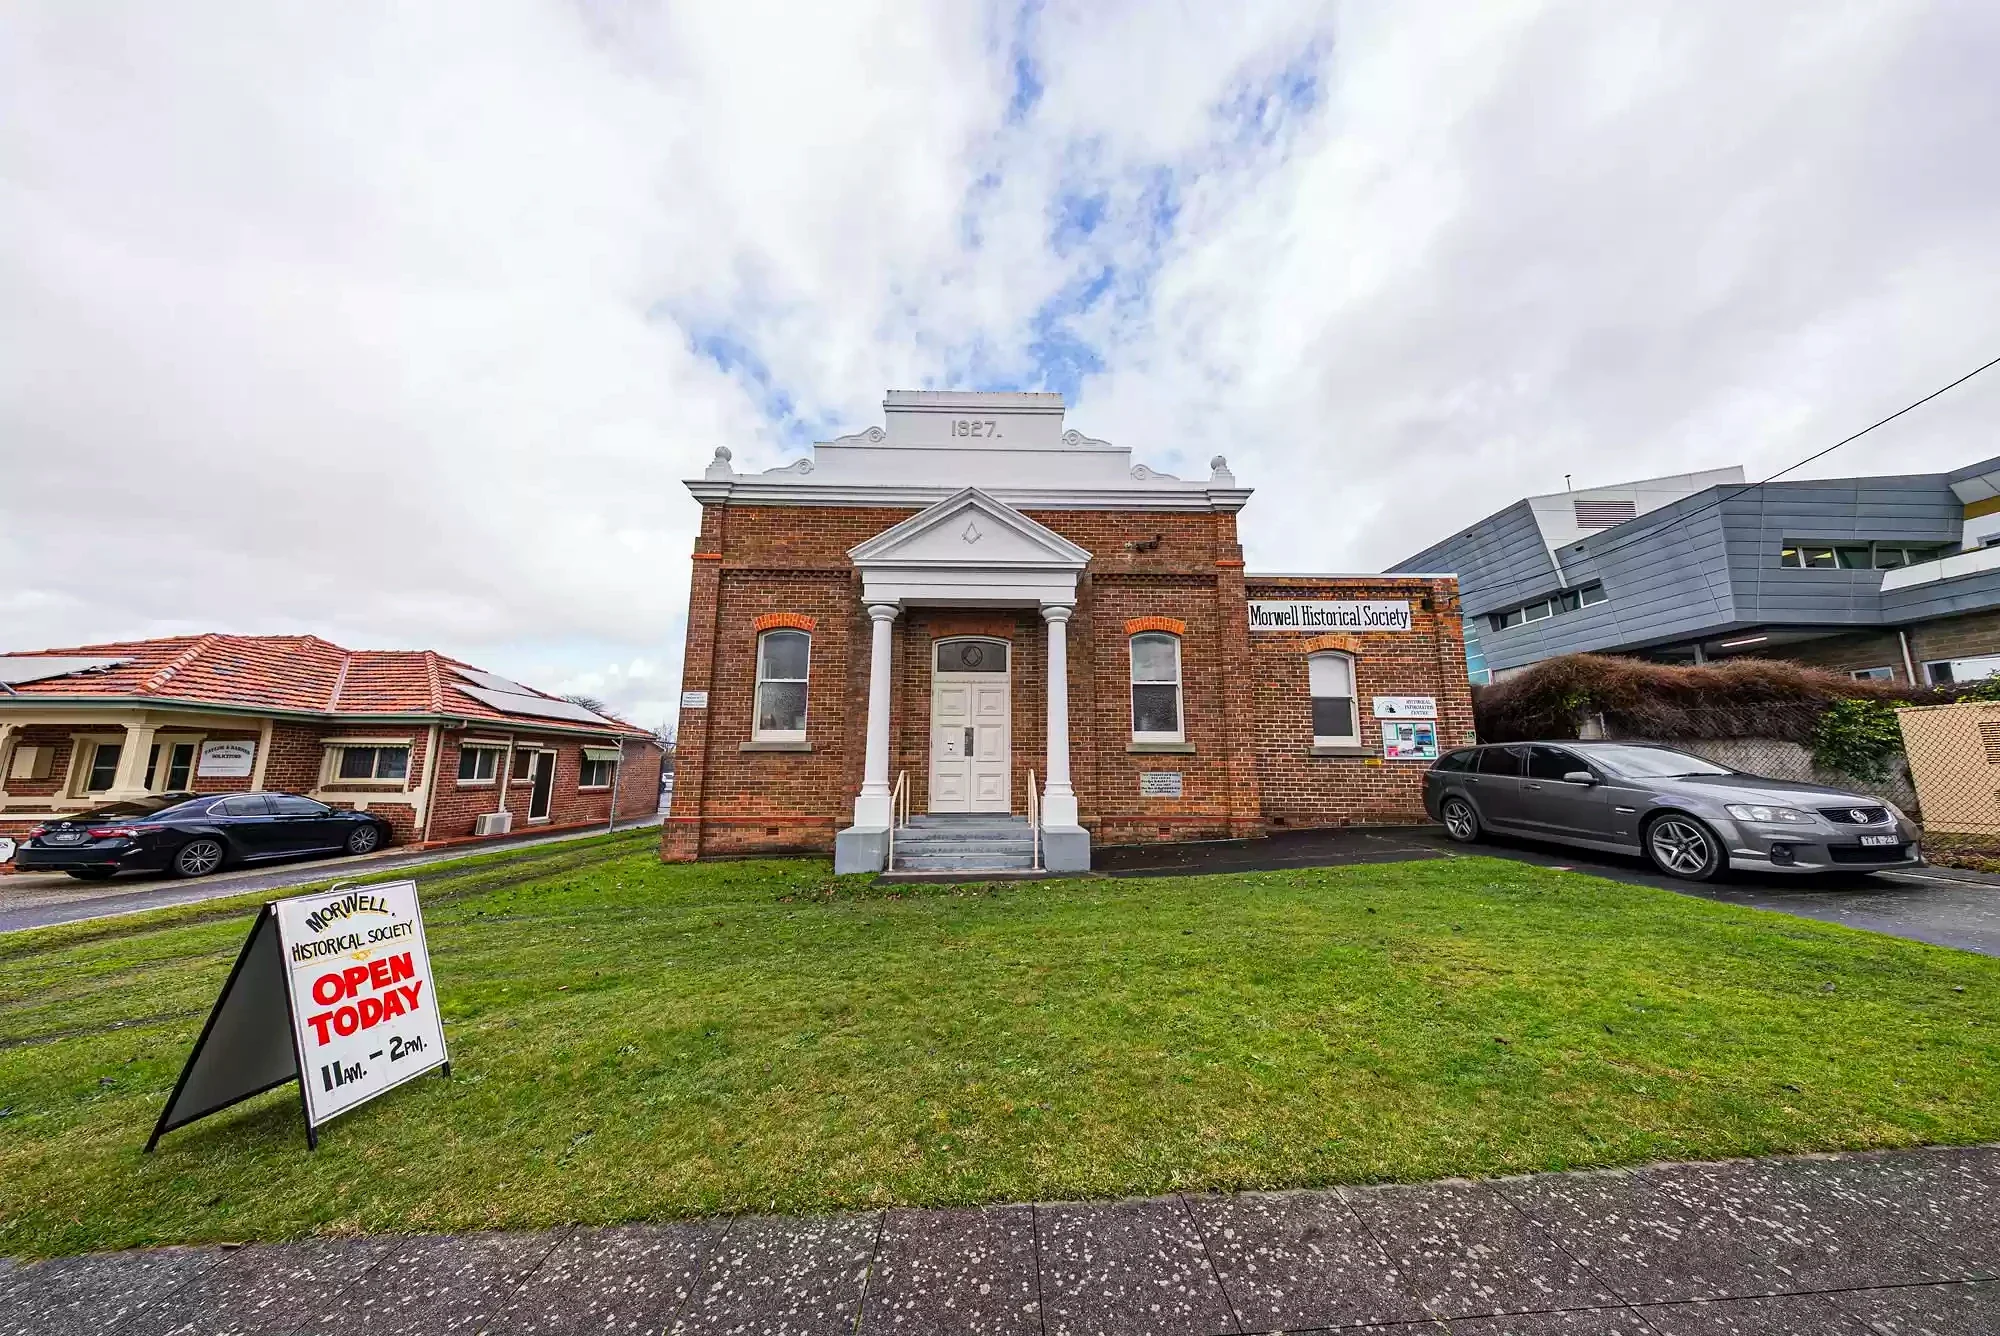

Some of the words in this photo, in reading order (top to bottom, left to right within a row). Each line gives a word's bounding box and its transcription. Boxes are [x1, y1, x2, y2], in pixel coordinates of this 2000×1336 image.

[1250, 605, 1299, 626] Morwell
[1301, 605, 1361, 626] Historical
[1363, 605, 1409, 629] Society
[291, 932, 366, 962] HISTORICAL
[368, 919, 413, 945] SOCIETY
[312, 951, 416, 1006] OPEN
[307, 980, 423, 1047] TODAY
[389, 1035, 428, 1063] 2PM.
